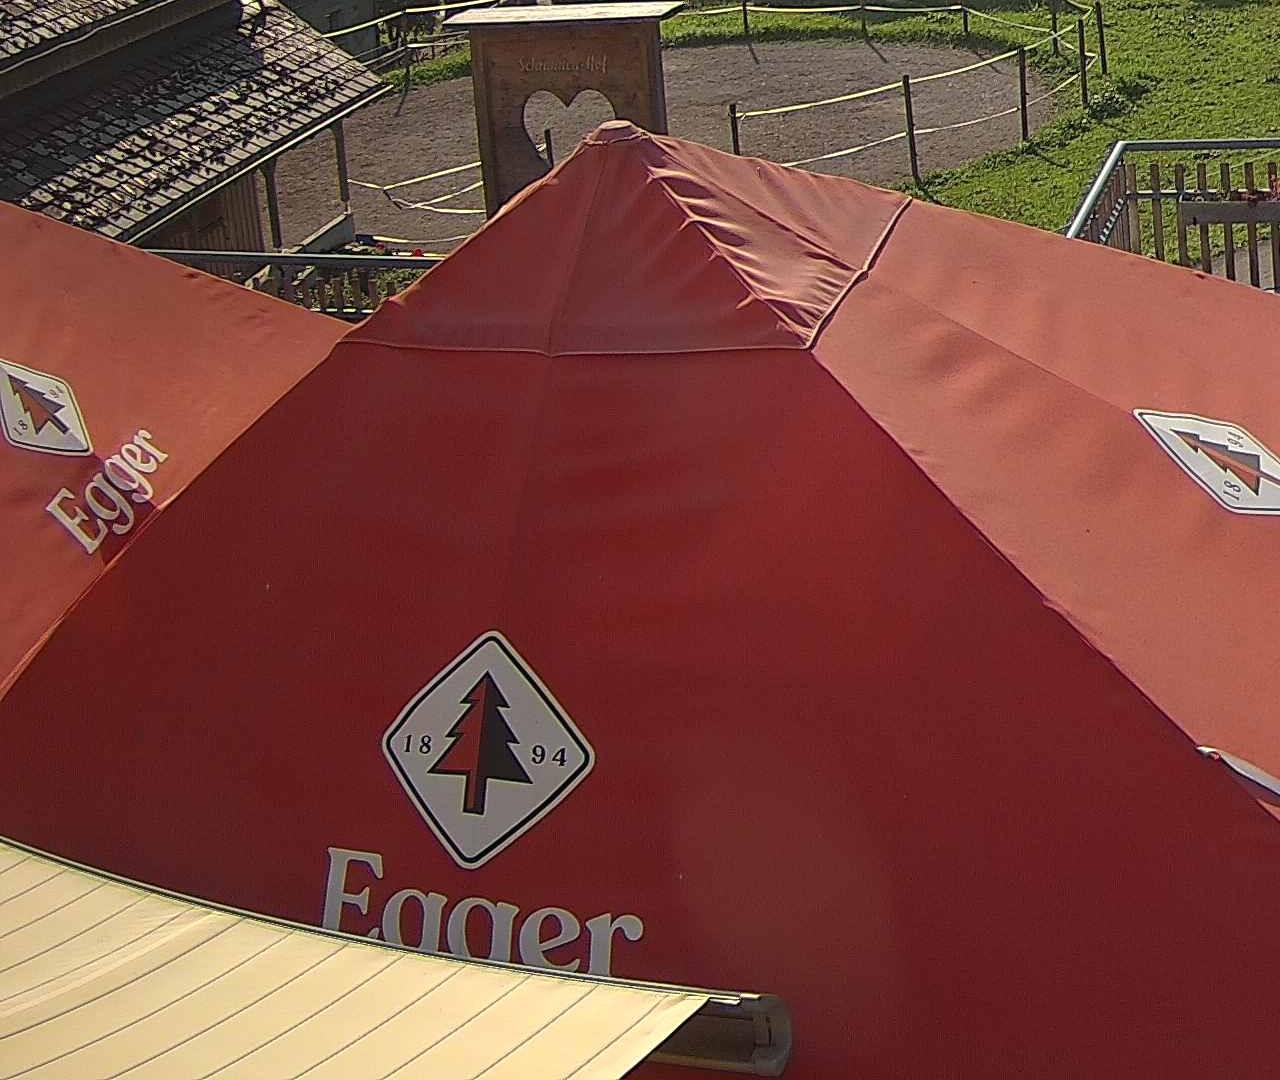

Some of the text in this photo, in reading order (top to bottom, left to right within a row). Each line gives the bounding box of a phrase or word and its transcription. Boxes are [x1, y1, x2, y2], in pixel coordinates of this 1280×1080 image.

[46, 429, 168, 554] Egger
[403, 734, 568, 767] 18 94
